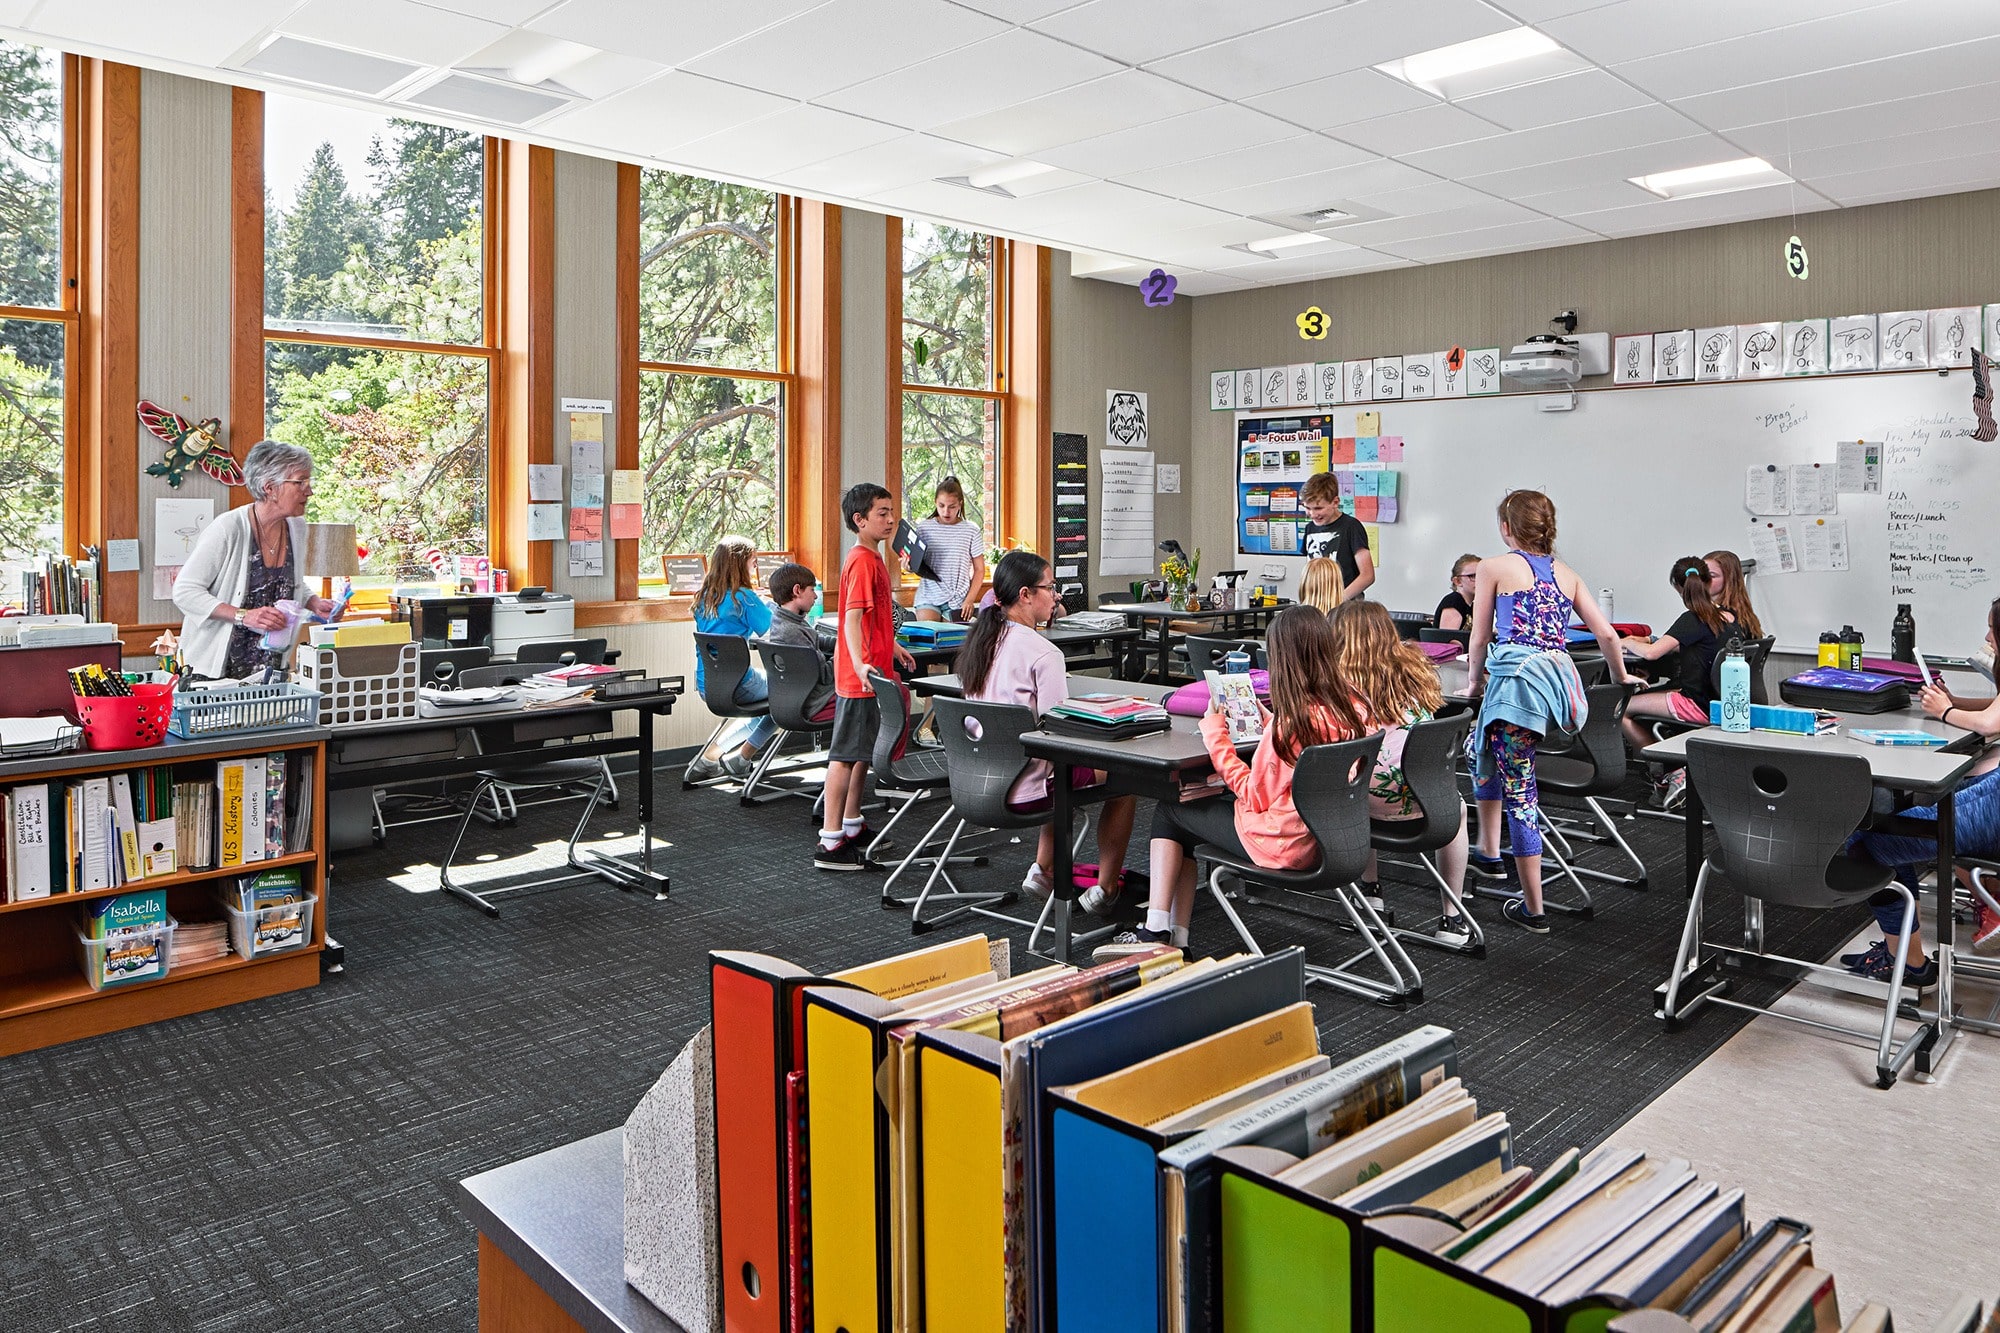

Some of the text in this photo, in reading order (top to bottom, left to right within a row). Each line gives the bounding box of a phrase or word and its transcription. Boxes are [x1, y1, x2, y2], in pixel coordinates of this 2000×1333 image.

[1790, 243, 1804, 275] 5
[1149, 274, 1168, 303] 2
[1305, 312, 1323, 337] 3
[1449, 348, 1460, 366] 4
[1627, 369, 1640, 379] Kk
[1412, 384, 1425, 394] Hh
[1480, 378, 1487, 388] Jj
[1297, 392, 1308, 401] Dd
[1324, 390, 1334, 400] Ee
[1354, 388, 1362, 397] Ff
[1381, 385, 1393, 395] Gg
[1218, 398, 1227, 407] Aa
[1243, 396, 1253, 405] Bb
[1269, 394, 1279, 403] Cc
[1779, 411, 1808, 433] Board
[1904, 412, 1956, 427] Schedule
[1269, 432, 1296, 443] Focus
[1298, 430, 1321, 441] Wall
[1911, 429, 1930, 445] May
[1890, 552, 1908, 561] Move
[1910, 552, 1932, 562] Tribes
[1938, 554, 1961, 562] Clean
[1962, 556, 1973, 565] up
[1892, 585, 1916, 596] Home
[25, 800, 36, 821] Rights
[225, 795, 242, 835] History
[18, 800, 27, 845] Constitution
[27, 832, 35, 843] Bill
[258, 879, 296, 887] Hutchinson
[111, 900, 160, 918] Isabella
[959, 999, 993, 1016] LEWIS
[999, 988, 1041, 1007] CLARK
[1229, 1114, 1258, 1132] THE
[1259, 1082, 1329, 1121] DECLARATION
[1336, 1043, 1410, 1079] INDEPENDENCE
